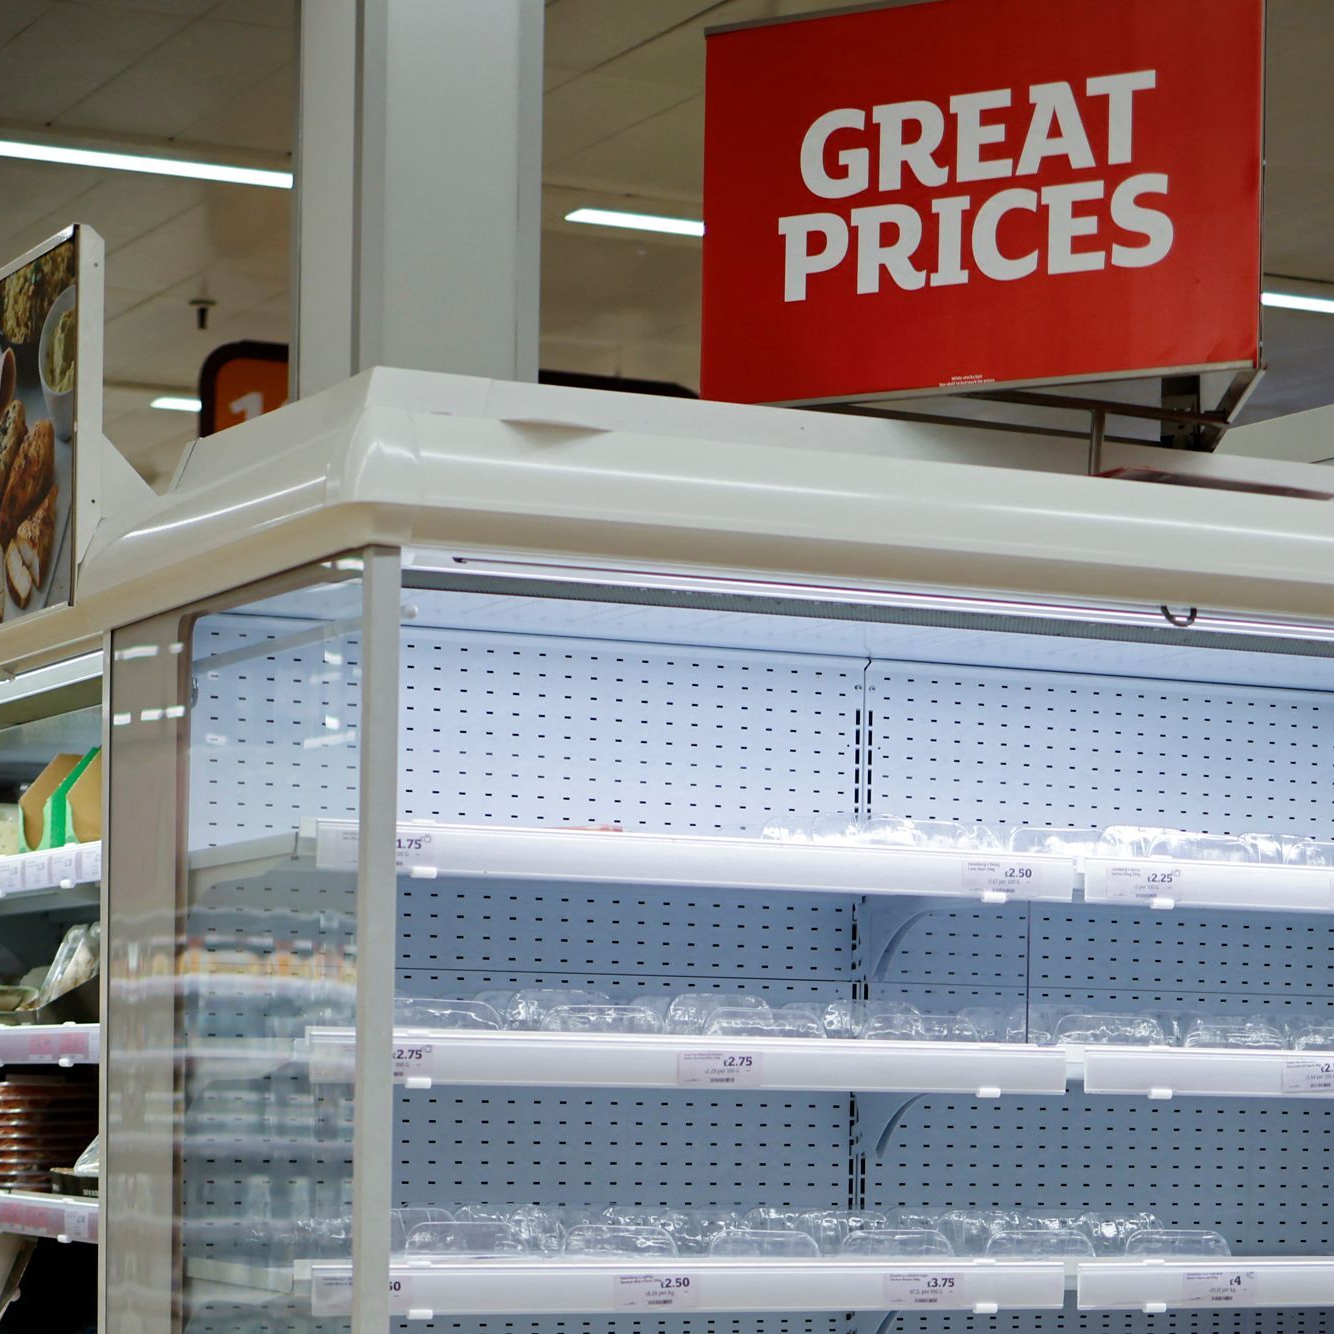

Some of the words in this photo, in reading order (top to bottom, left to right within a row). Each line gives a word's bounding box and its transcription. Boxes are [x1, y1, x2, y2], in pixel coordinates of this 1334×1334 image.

[800, 69, 1156, 199] GREAT
[778, 172, 1174, 302] PRICES
[1005, 868, 1032, 878] £2.50
[1147, 873, 1173, 883] £2.25
[723, 1056, 753, 1067] £2.75
[661, 1277, 690, 1289] £2.50
[927, 1277, 955, 1288] £3.75
[1229, 1275, 1242, 1286] £4
